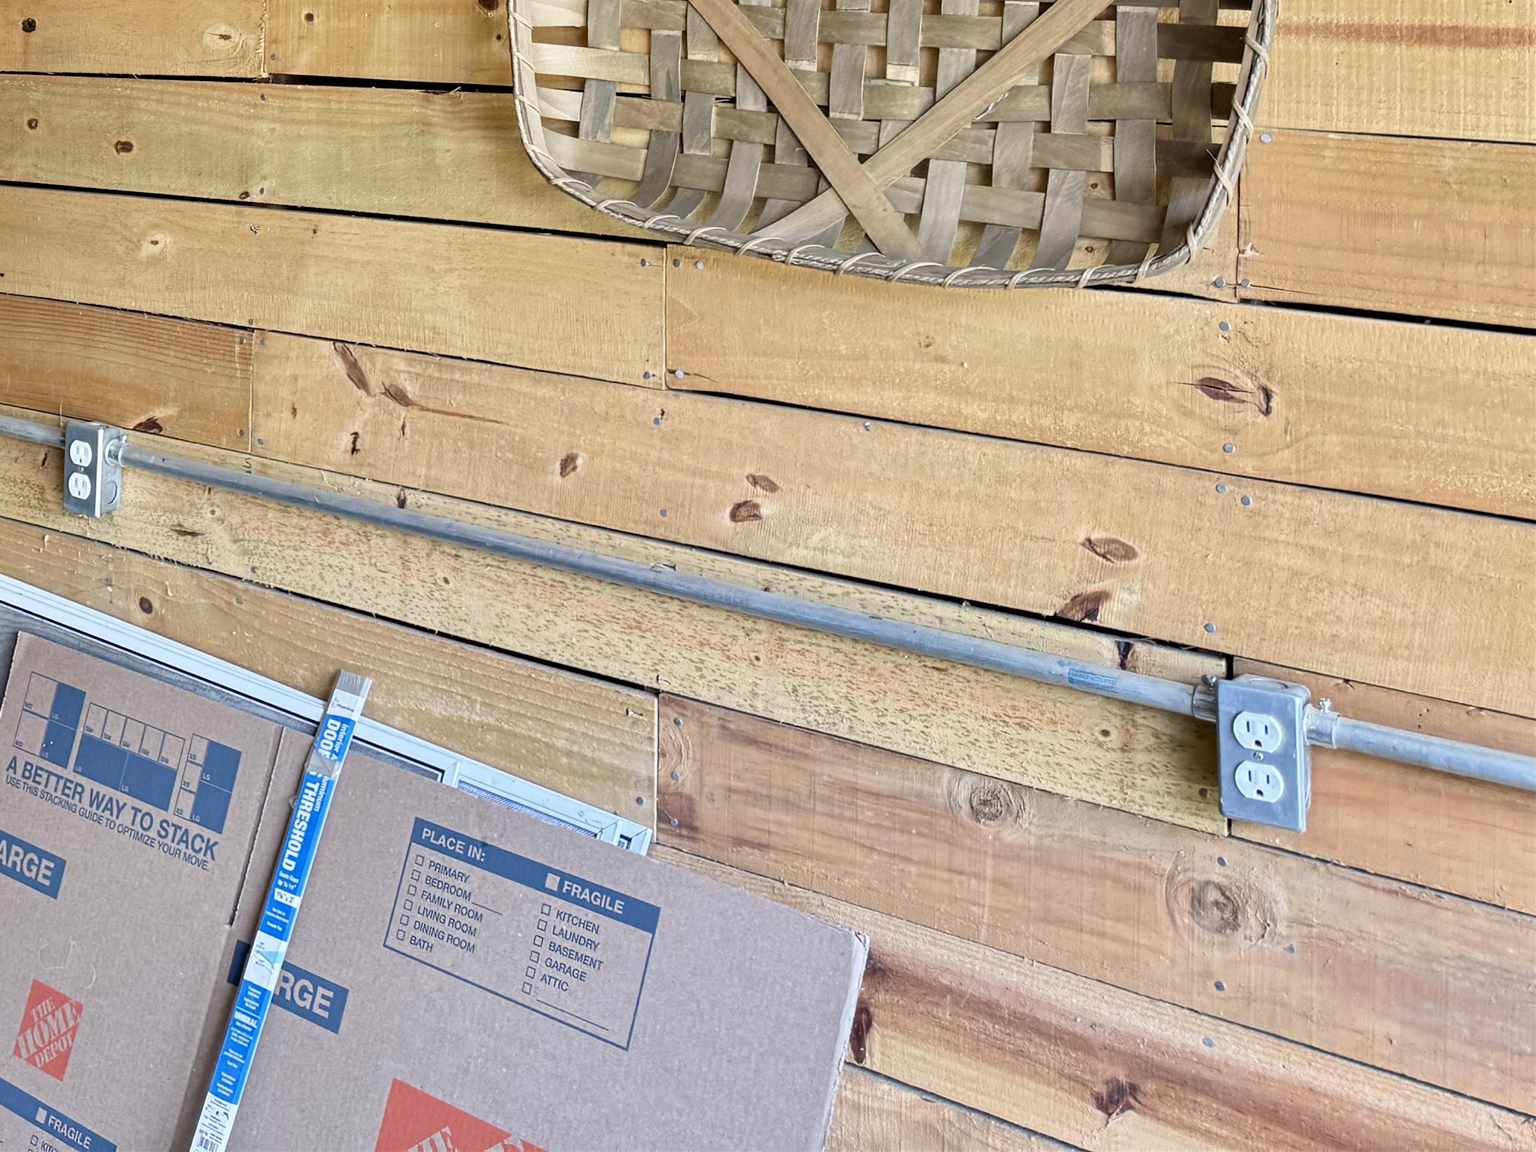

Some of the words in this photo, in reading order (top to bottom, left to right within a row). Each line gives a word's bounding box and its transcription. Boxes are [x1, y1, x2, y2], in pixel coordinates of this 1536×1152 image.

[6, 755, 18, 775] A
[21, 761, 85, 803] BETTER
[88, 787, 127, 820] WAY
[130, 806, 154, 832] TO
[157, 819, 219, 861] STACK
[6, 775, 22, 790] USE
[21, 783, 39, 797] THIS
[39, 788, 78, 814] STACKING
[78, 807, 104, 825] GUIDE
[104, 819, 116, 831] TO
[116, 823, 157, 849] OPTIMIZE
[157, 840, 182, 859] YOUR
[282, 782, 320, 871] THRESHOLD
[422, 828, 465, 854] PLACE
[467, 844, 485, 862] IN:
[428, 860, 471, 883] PRIMARY
[425, 875, 472, 901] BEDROOM
[562, 880, 625, 914] FRAGILE
[417, 905, 446, 925] LIVING
[447, 917, 477, 937] ROOM
[421, 890, 453, 909] FAMILY
[454, 903, 483, 923] ROOM
[556, 910, 600, 935] KITCHEN
[409, 935, 433, 953] BATH
[413, 920, 445, 941] DINING
[446, 934, 475, 954] ROOM
[552, 925, 600, 952] LAUNDRY
[544, 957, 587, 982] GARAGE
[549, 941, 604, 971] BASEMENT
[541, 973, 569, 992] ATTIC
[48, 1115, 92, 1149] FRAGILE
